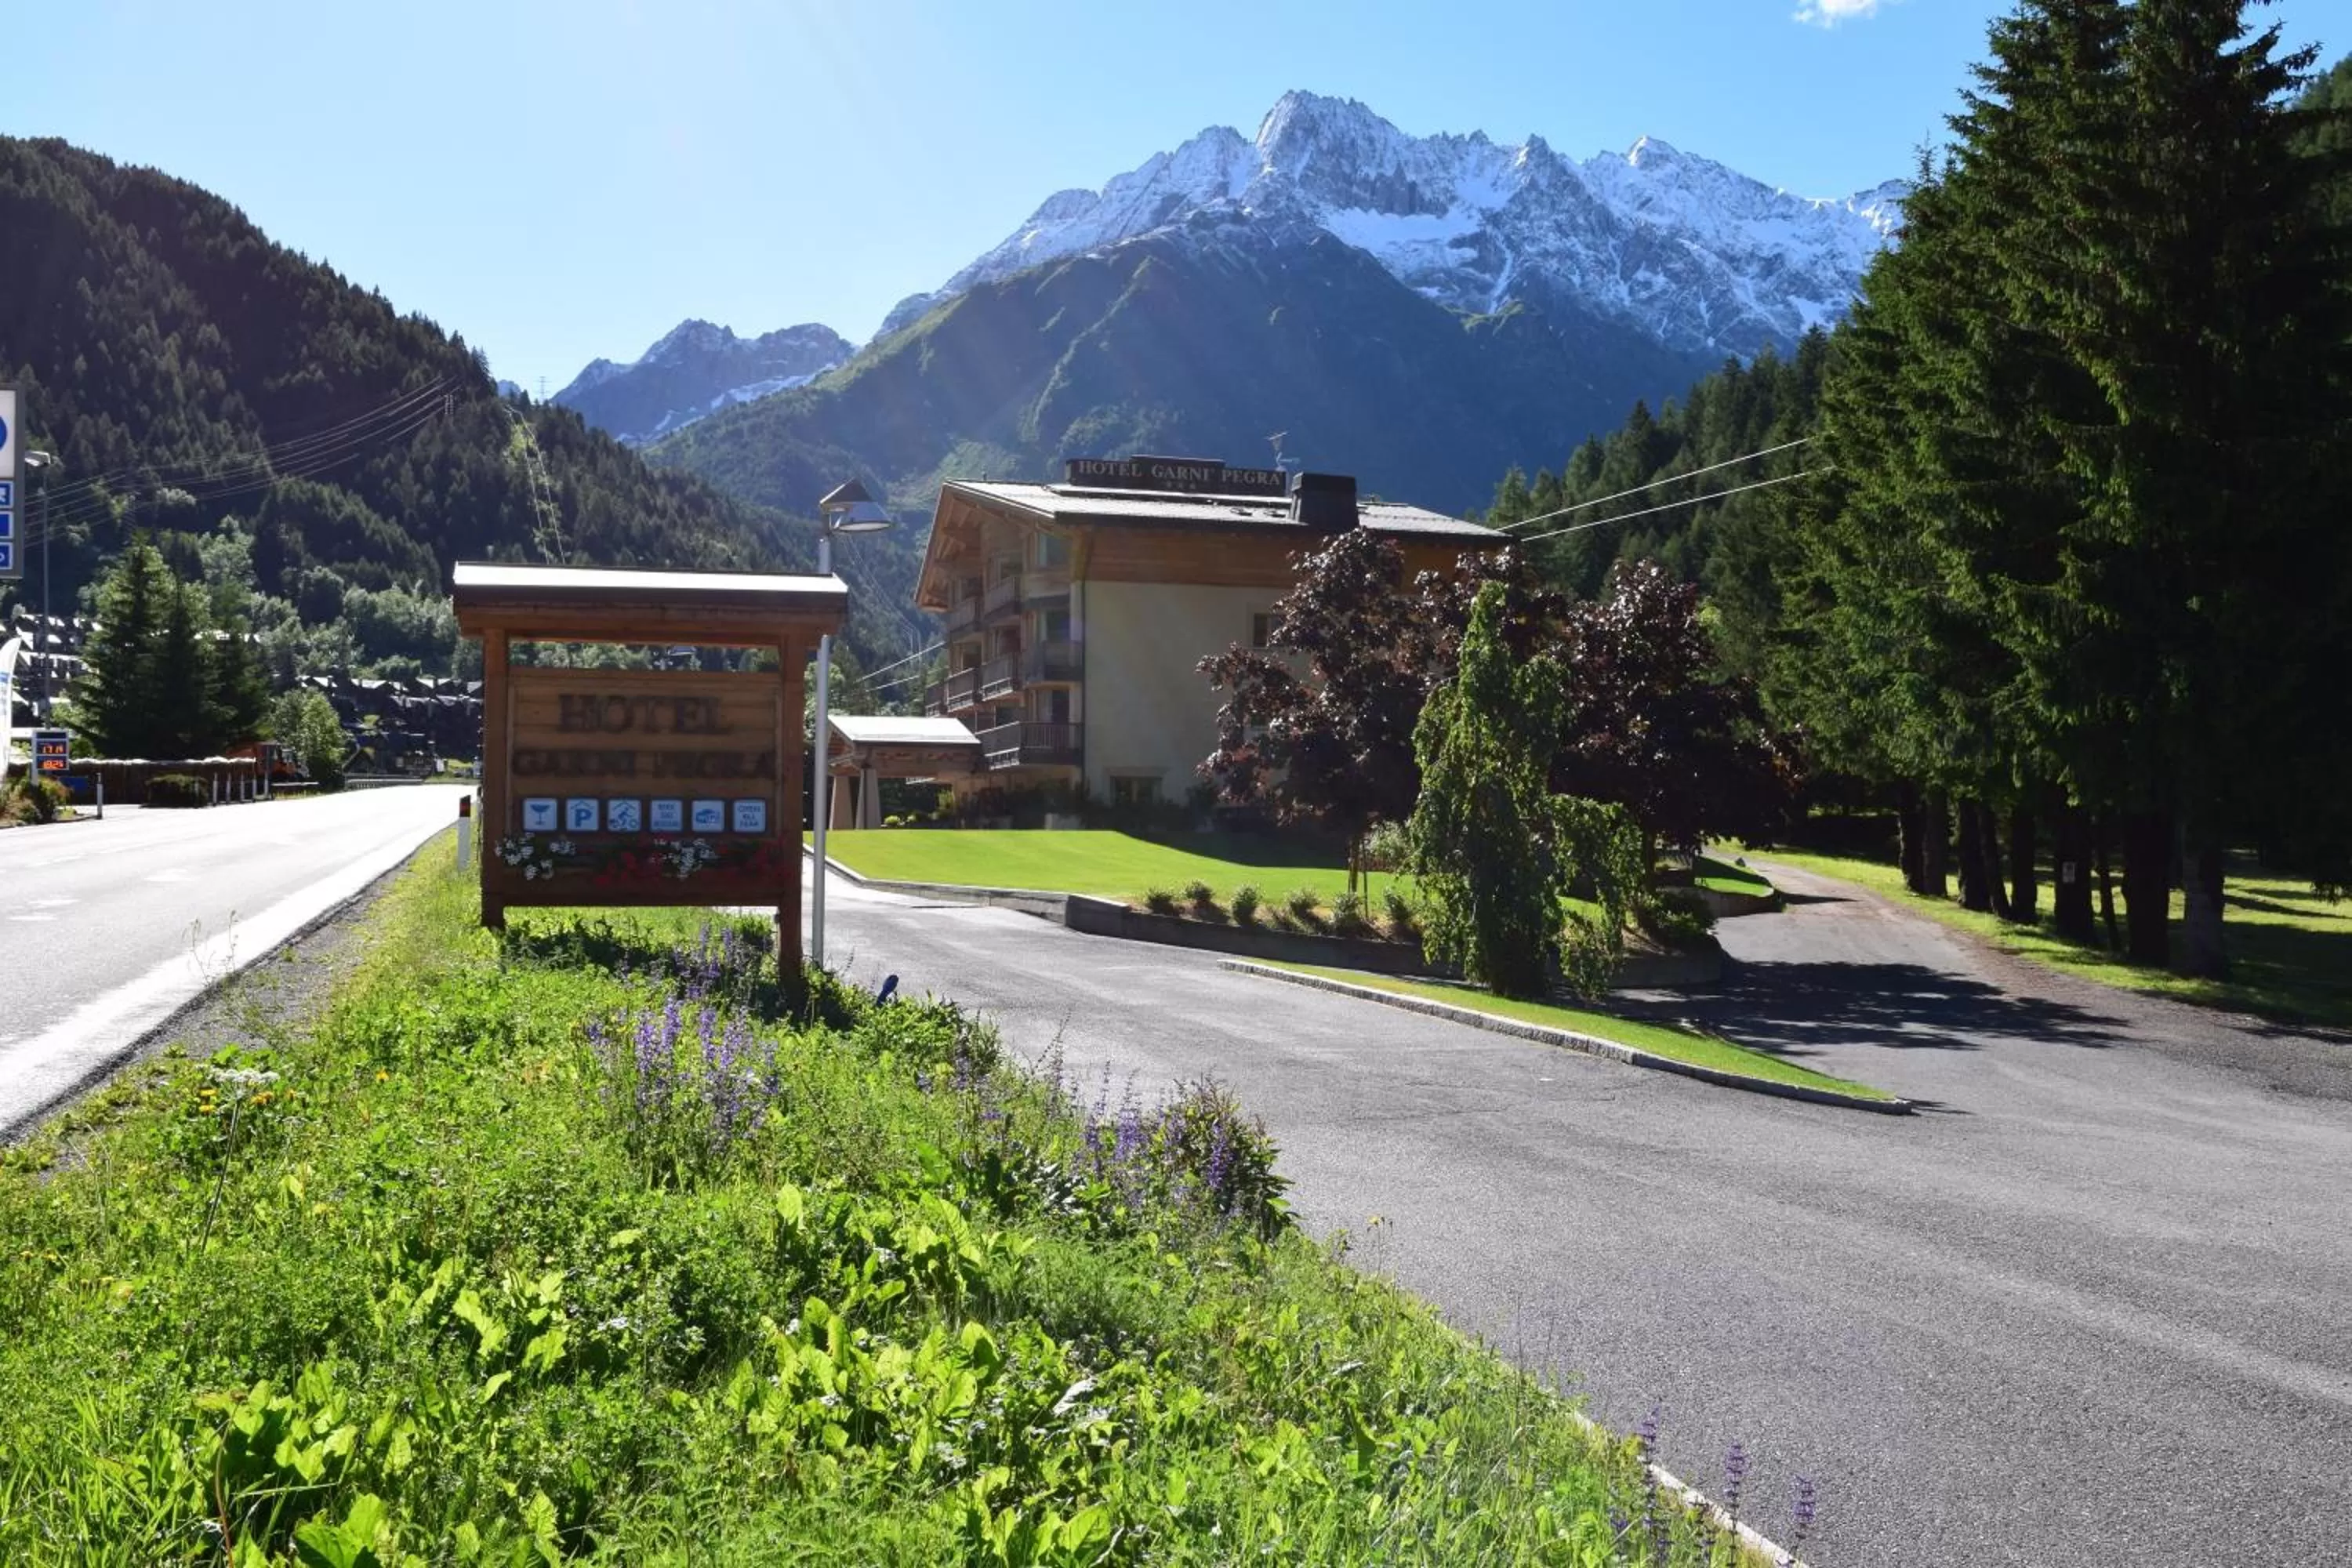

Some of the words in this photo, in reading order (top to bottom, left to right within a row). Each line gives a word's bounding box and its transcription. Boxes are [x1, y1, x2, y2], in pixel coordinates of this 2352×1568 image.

[1078, 460, 1142, 477] HOTEL
[557, 694, 731, 734] HOTEL
[575, 808, 593, 828] P
